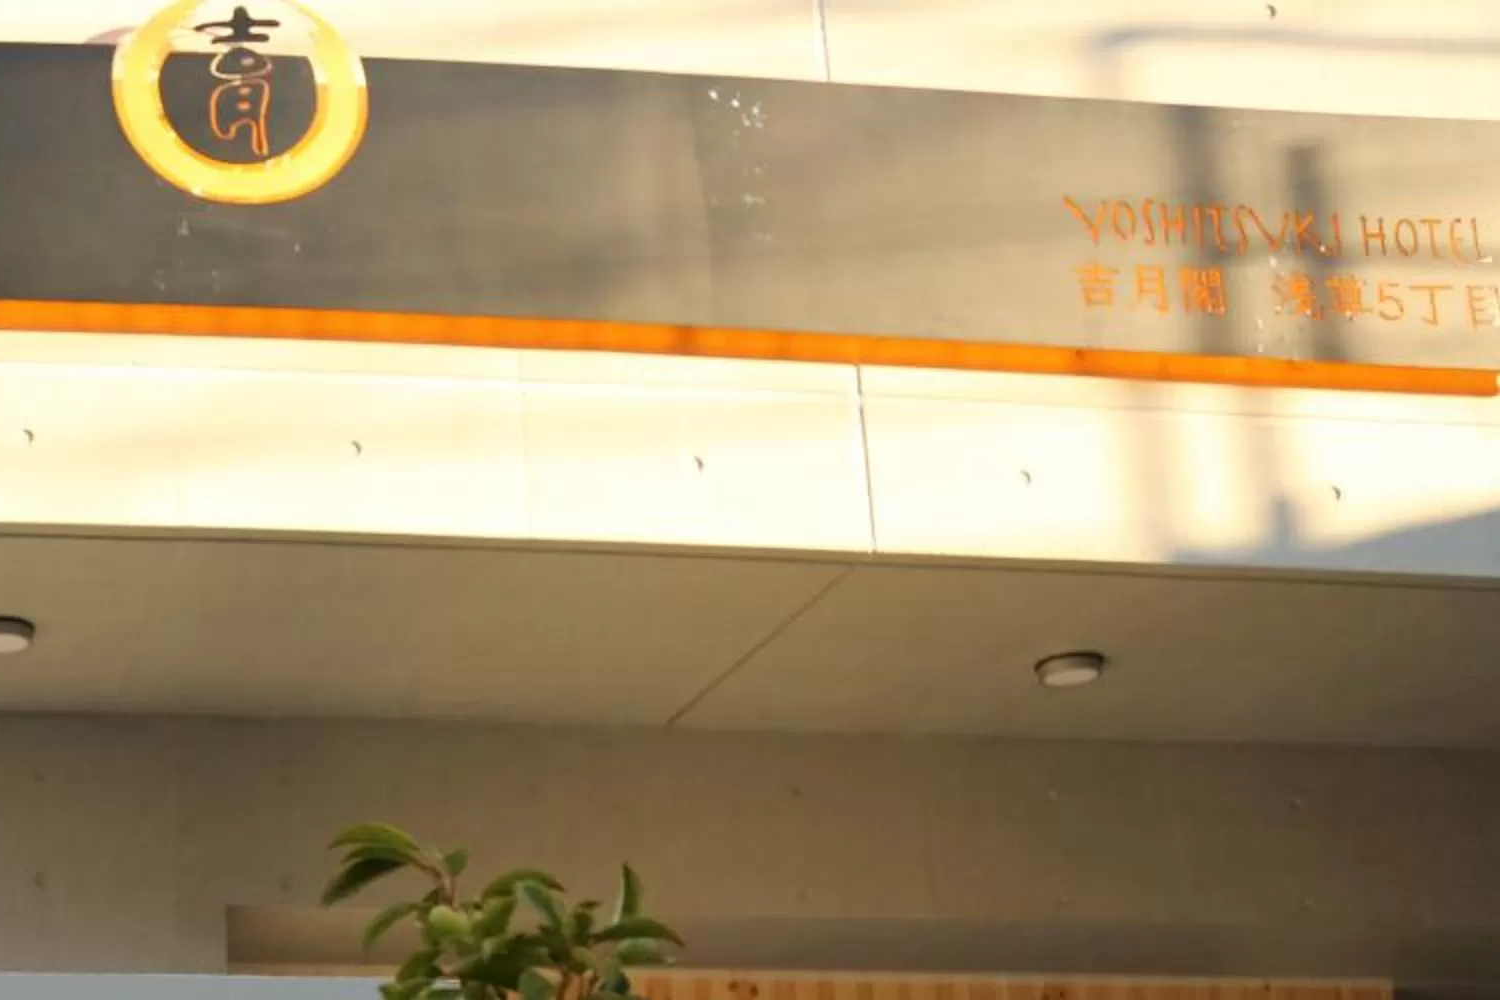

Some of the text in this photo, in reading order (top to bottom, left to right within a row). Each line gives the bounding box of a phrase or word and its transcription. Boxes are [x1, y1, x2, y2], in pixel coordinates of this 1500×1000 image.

[1359, 214, 1492, 265] HOTEL
[1071, 261, 1227, 317] 吉月閣
